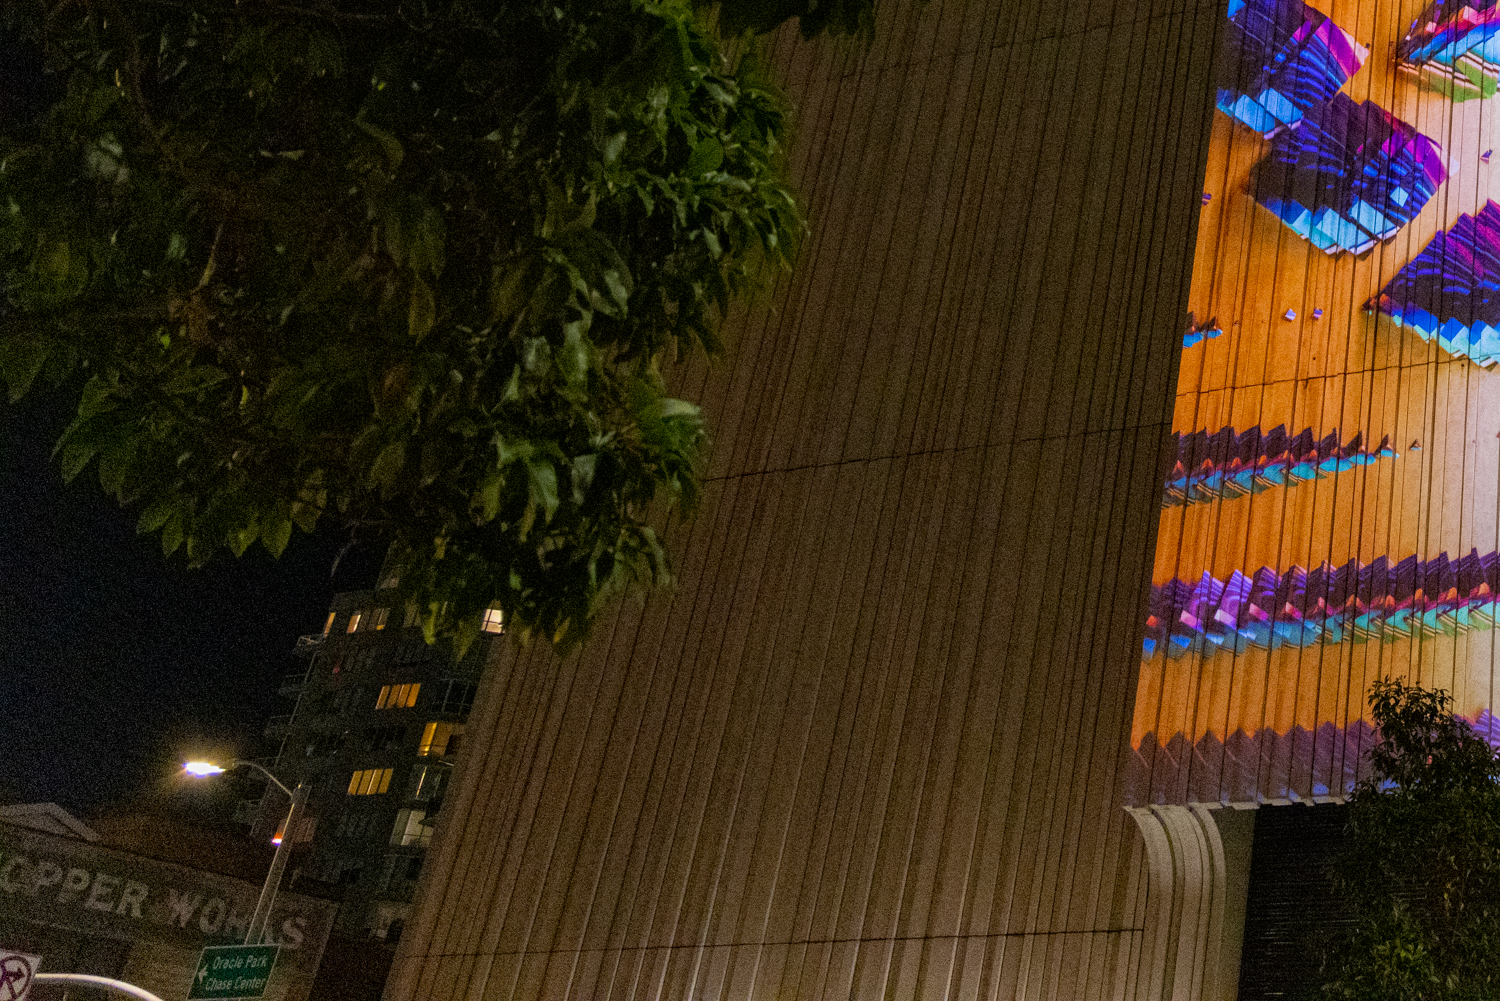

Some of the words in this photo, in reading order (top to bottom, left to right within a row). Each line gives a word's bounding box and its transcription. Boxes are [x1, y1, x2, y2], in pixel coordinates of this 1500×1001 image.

[213, 956, 244, 970] Oracle
[245, 954, 267, 969] Park
[205, 977, 233, 991] Chase
[234, 975, 266, 990] Center
